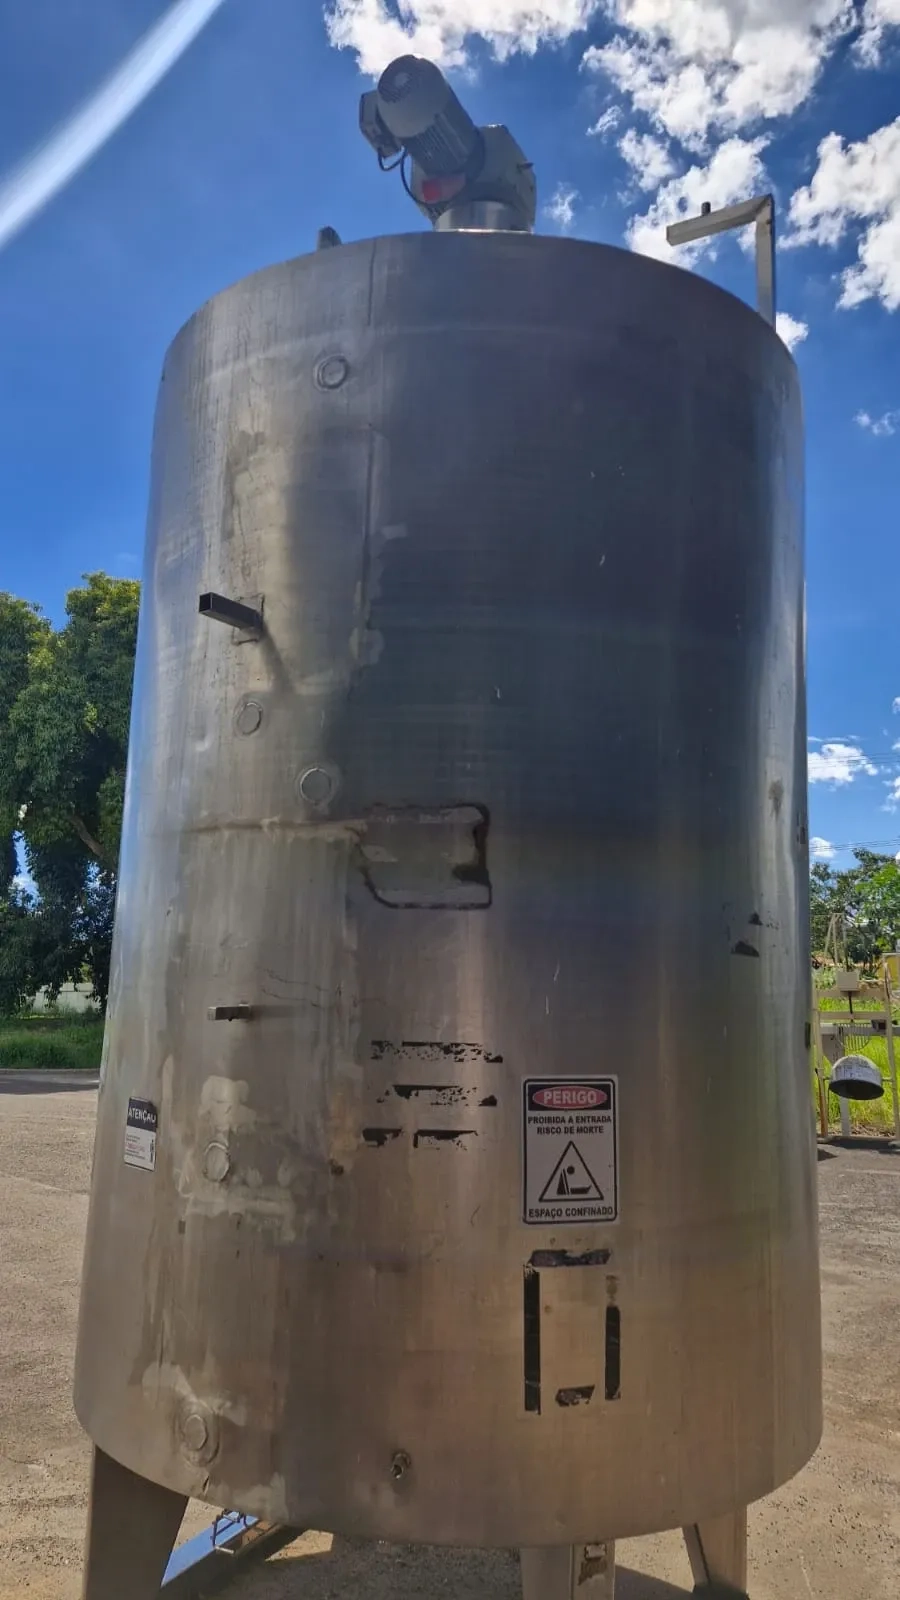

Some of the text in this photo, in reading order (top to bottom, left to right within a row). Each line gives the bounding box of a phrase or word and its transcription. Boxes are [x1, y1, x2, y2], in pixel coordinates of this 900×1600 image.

[543, 1091, 597, 1104] PERIGO
[528, 1115, 611, 1124] PROIBIDA A ENTRADA
[537, 1125, 604, 1135] RISCO DE MORTE
[529, 1206, 613, 1219] ESPAÇO CONFINADO
